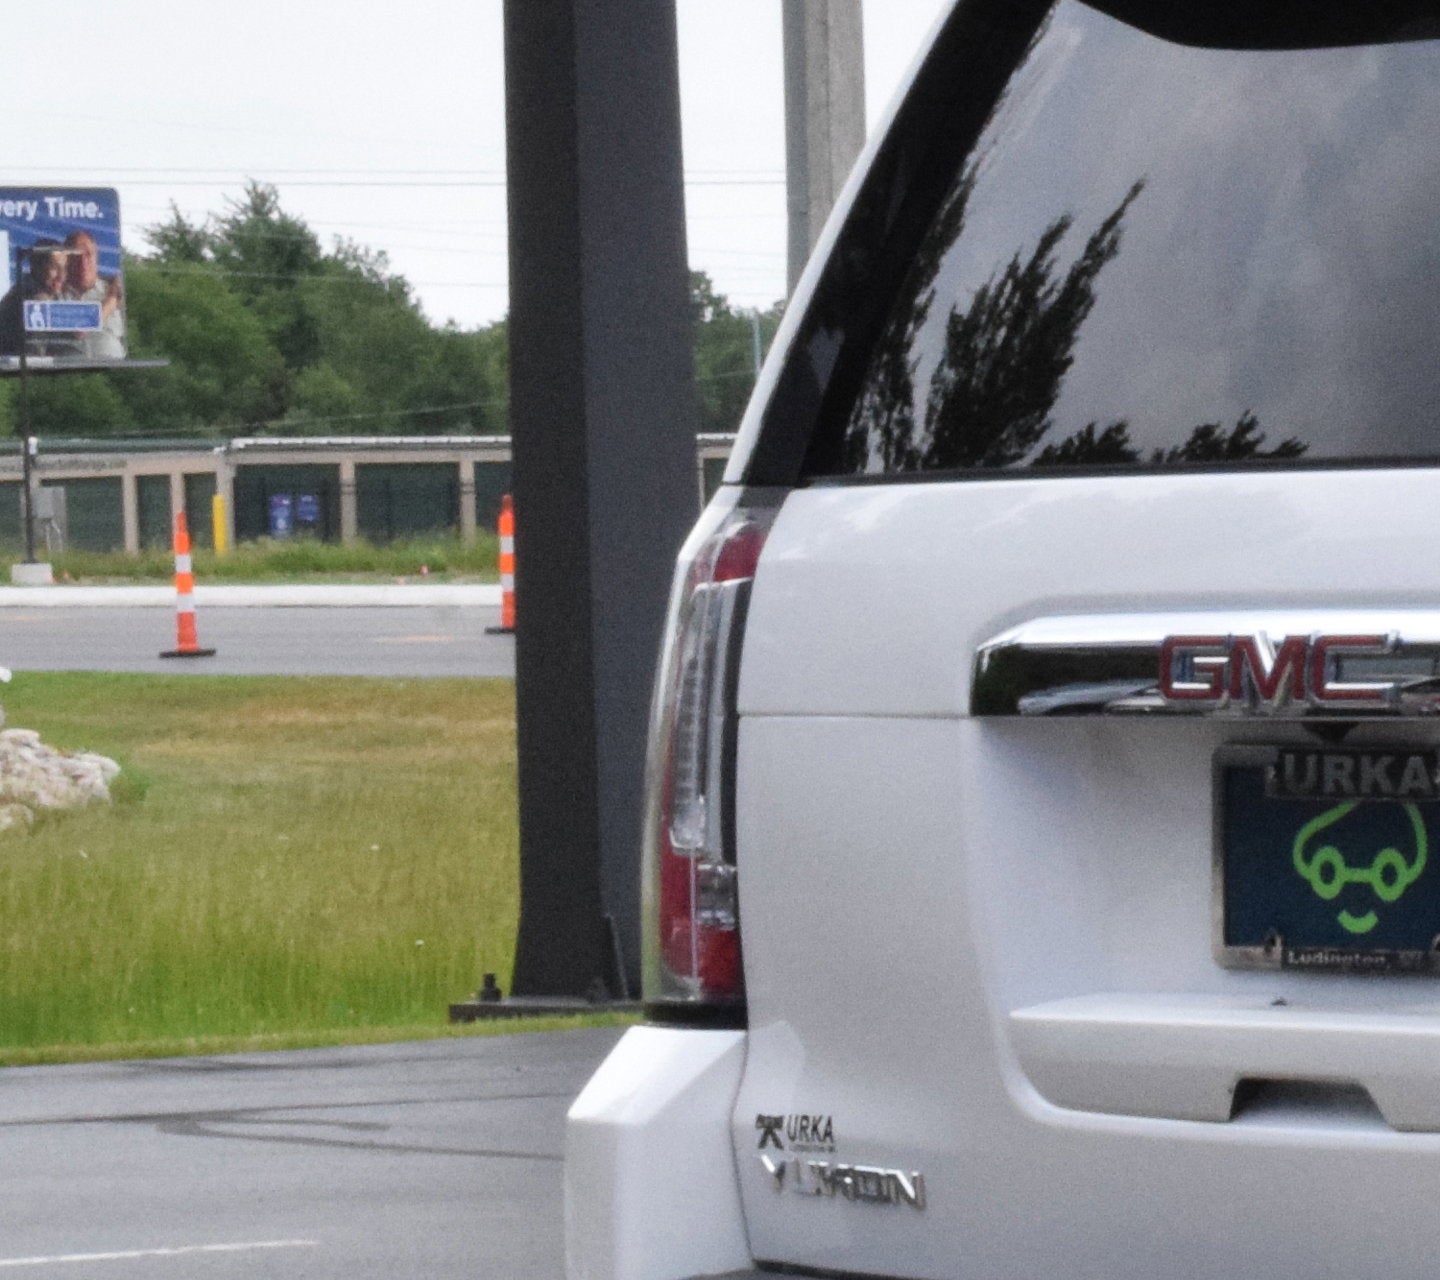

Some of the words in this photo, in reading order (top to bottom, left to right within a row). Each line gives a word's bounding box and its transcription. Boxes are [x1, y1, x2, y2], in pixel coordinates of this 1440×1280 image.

[0, 201, 38, 221] ery
[44, 196, 104, 218] Time.
[1159, 632, 1399, 704] GMC
[1284, 753, 1434, 794] URKA
[786, 1114, 834, 1143] URKA
